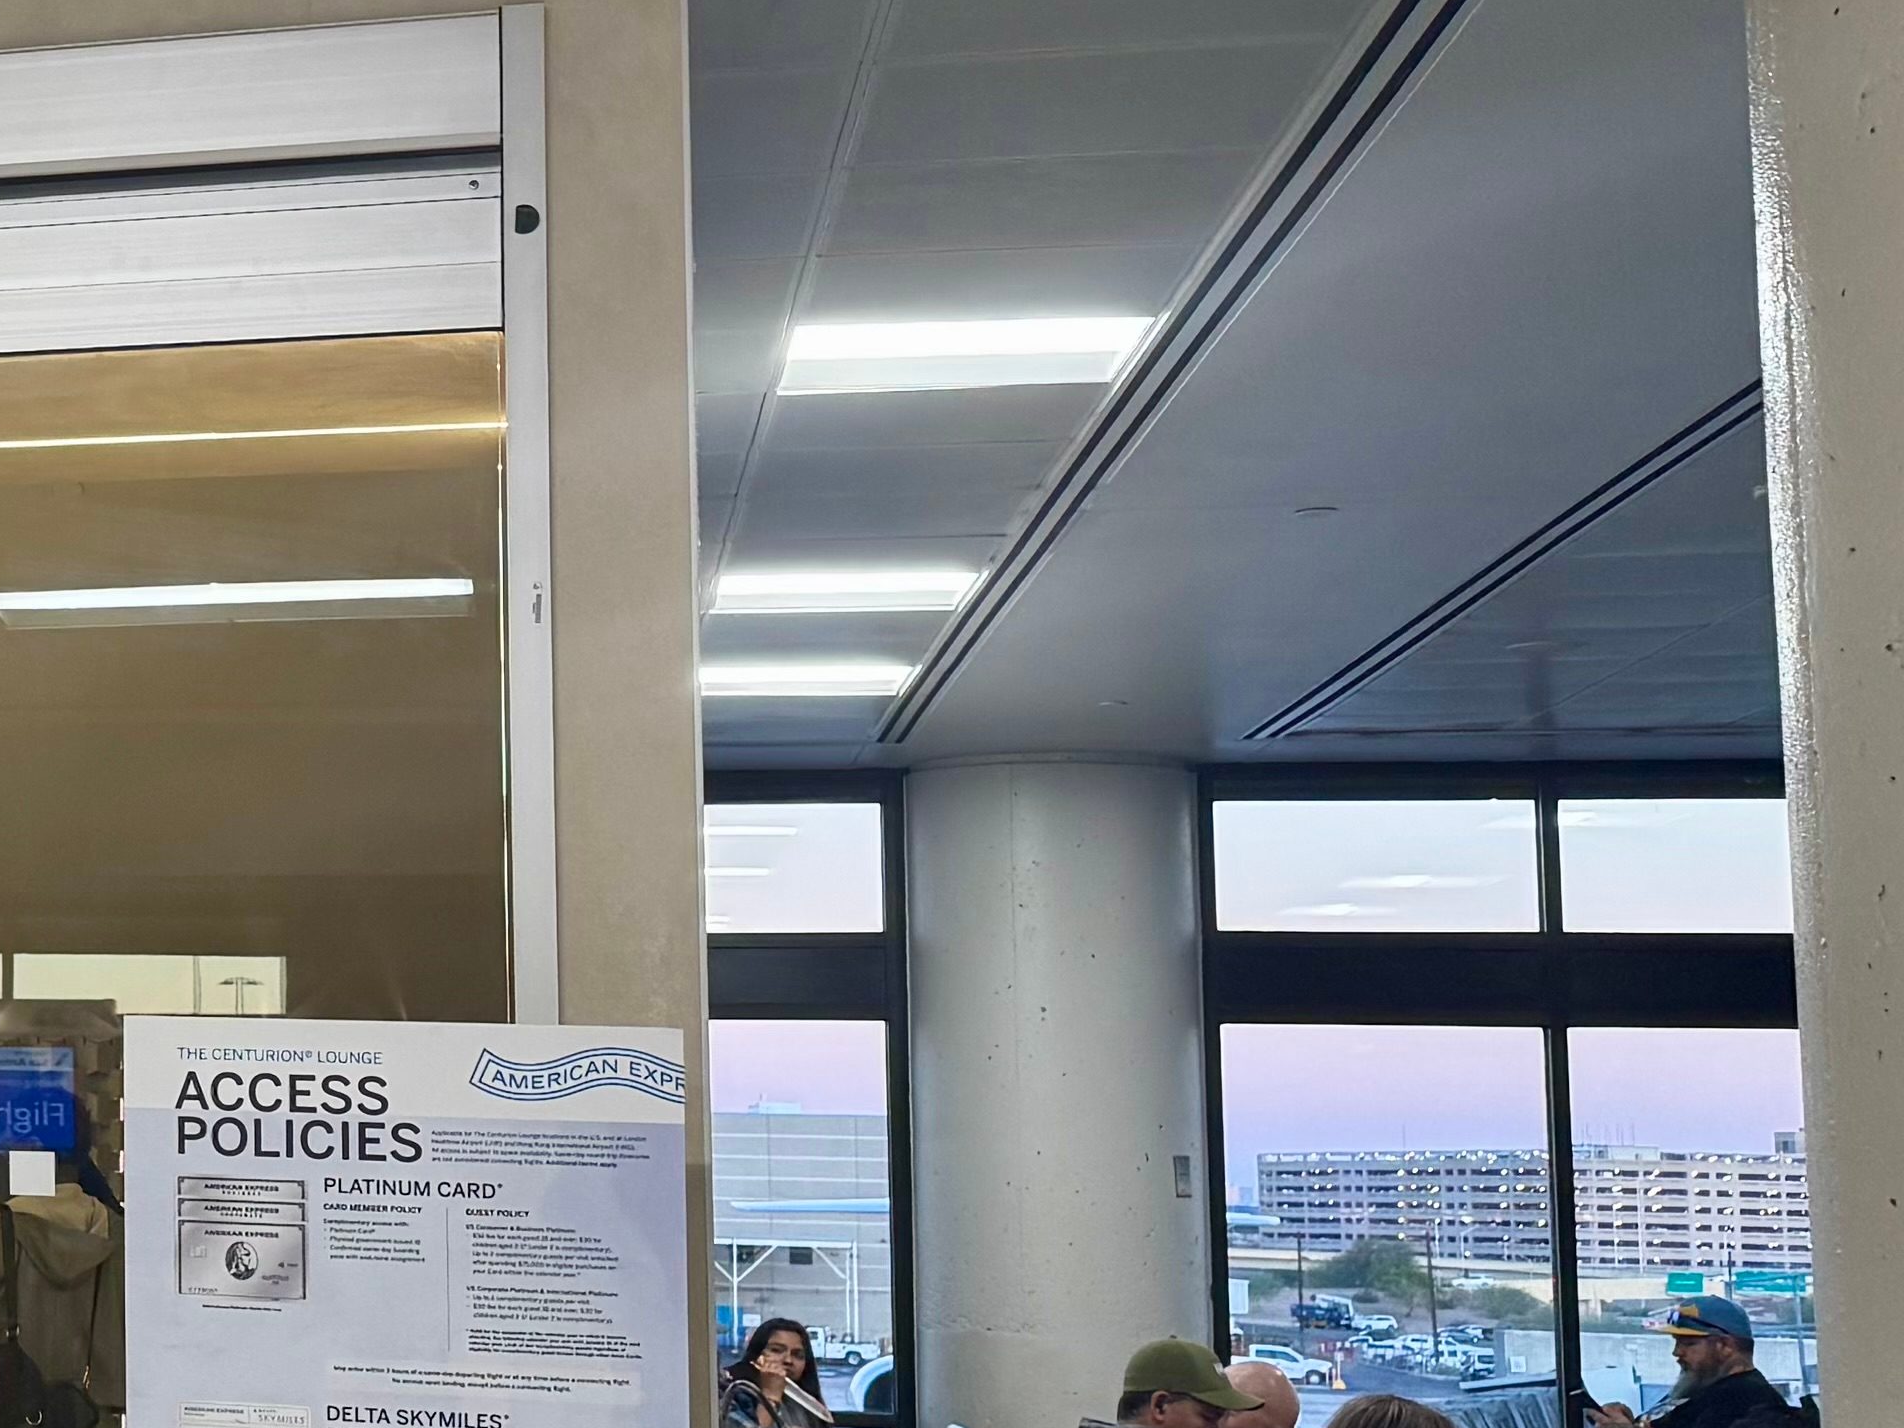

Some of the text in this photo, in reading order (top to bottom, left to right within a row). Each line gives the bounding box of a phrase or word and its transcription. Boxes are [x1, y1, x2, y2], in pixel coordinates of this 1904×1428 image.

[177, 1047, 207, 1060] THE
[318, 1051, 383, 1065] LOUNGE
[492, 1059, 618, 1090] AMERICAN
[175, 1071, 389, 1116] ACCESS
[177, 1116, 423, 1163] POLICIES
[323, 1178, 431, 1197] PLATINUM
[327, 1405, 390, 1424] DELTA
